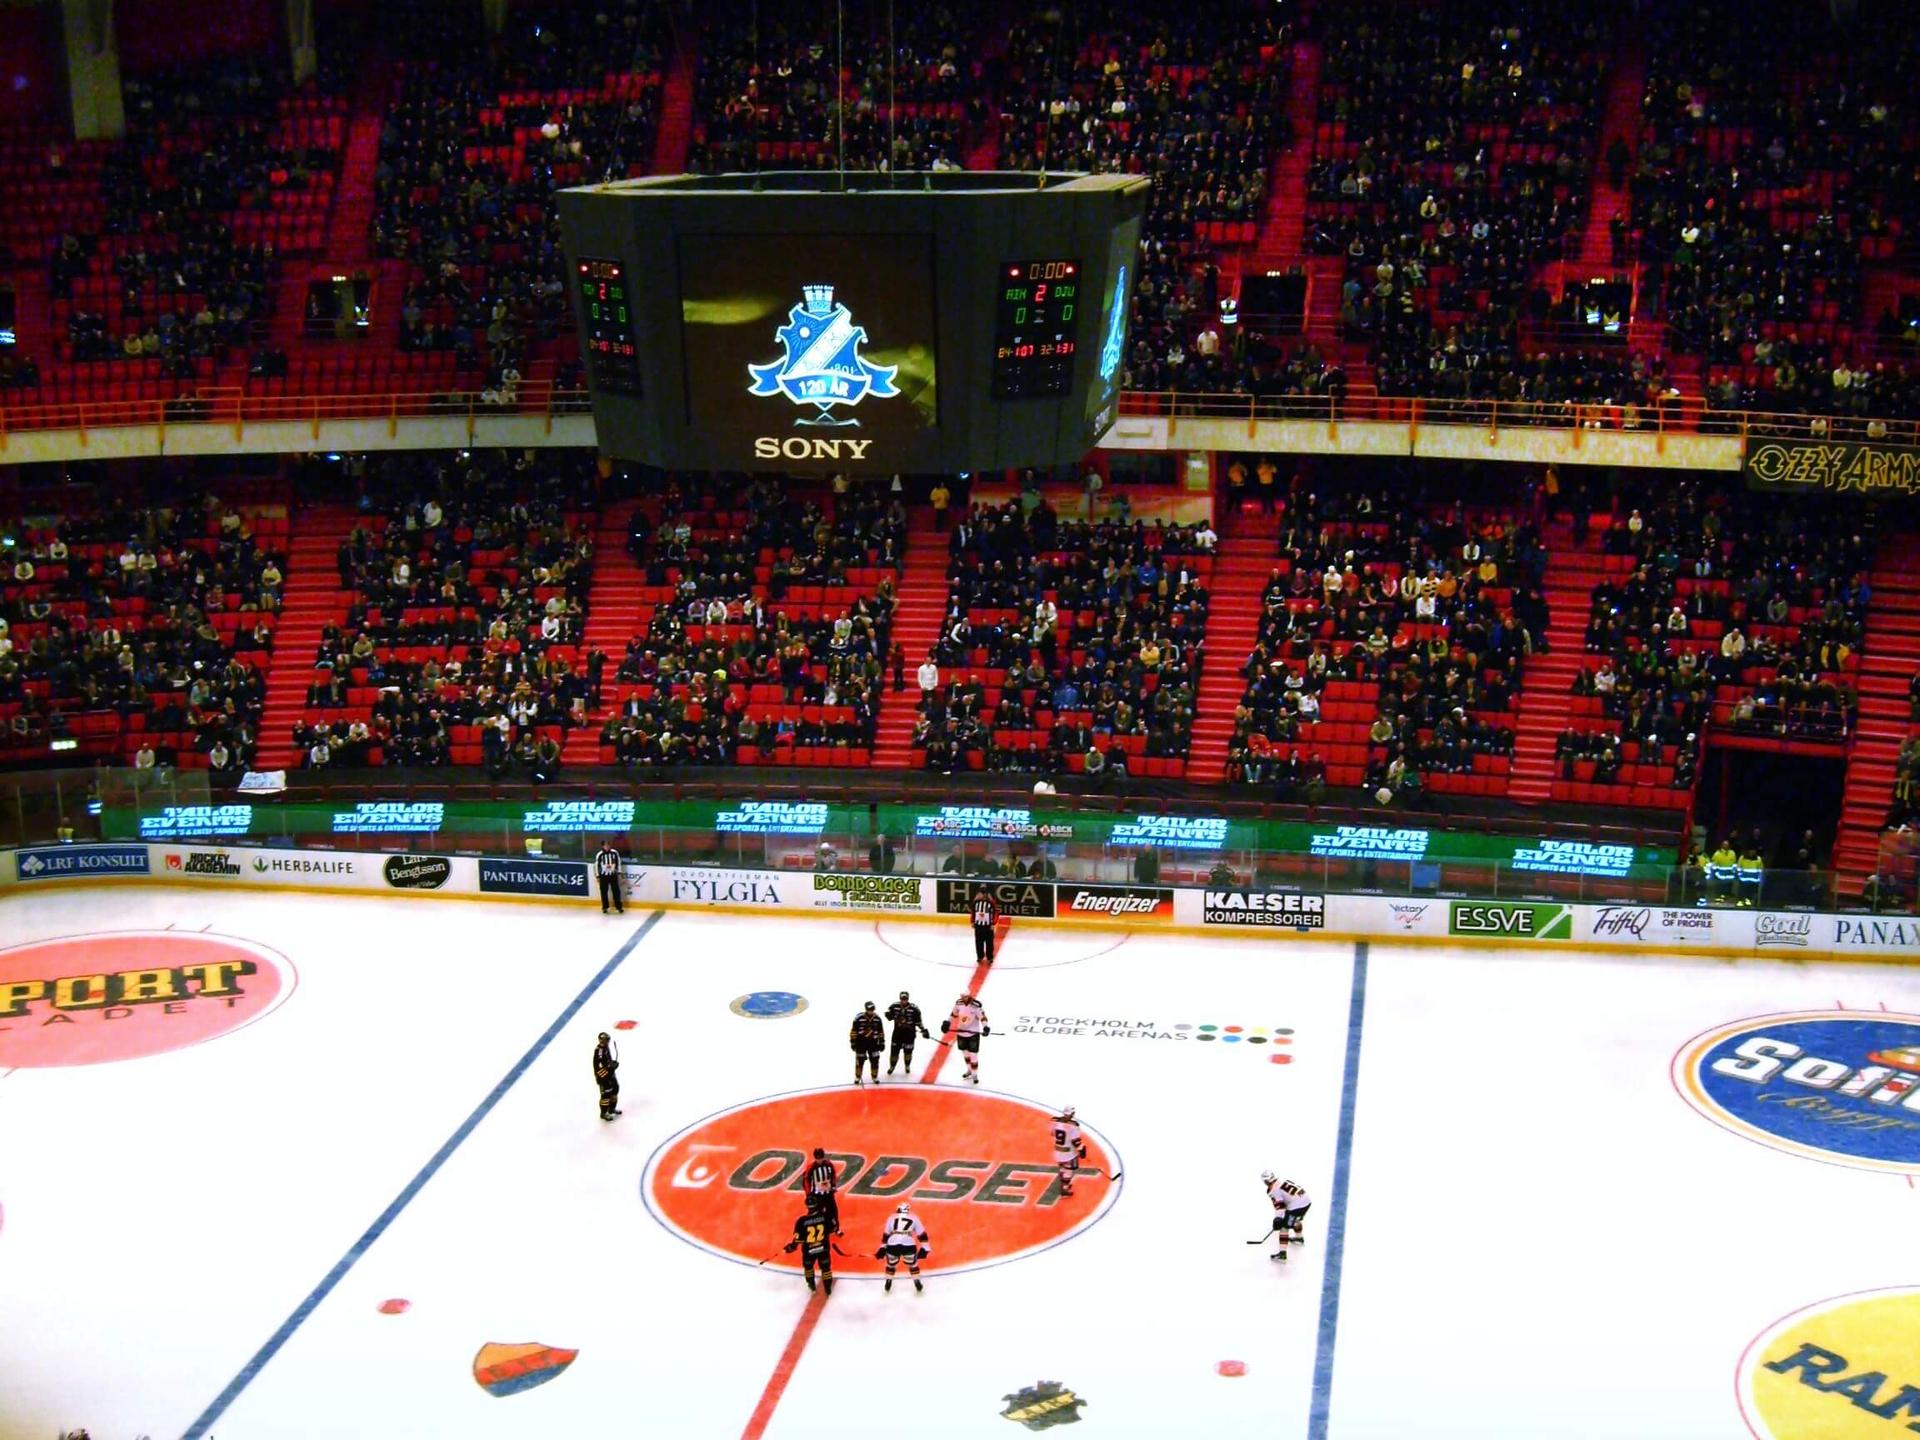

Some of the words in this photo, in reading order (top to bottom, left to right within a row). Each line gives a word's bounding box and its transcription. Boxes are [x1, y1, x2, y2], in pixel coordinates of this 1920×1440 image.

[1029, 262, 1066, 280] 0:00
[1035, 284, 1047, 302] 2
[1055, 286, 1075, 298] DJU
[1015, 307, 1026, 324] 0
[1062, 304, 1073, 321] 0
[799, 379, 825, 396] 120
[755, 437, 872, 459] SONY
[1749, 444, 1846, 487] OZZY
[357, 803, 444, 813] TAILOR
[547, 802, 635, 812] TAILOR
[740, 802, 828, 814] TAILOR
[941, 806, 1030, 820] TAILOR
[141, 816, 252, 828] EVENTS
[333, 813, 444, 824] EVENTS
[523, 812, 635, 822] EVENTS
[716, 812, 828, 824] EVENTS
[1137, 816, 1228, 830] TAILOR
[1112, 825, 1227, 840] EVENTS
[1337, 826, 1429, 841] TAILOR
[1311, 835, 1428, 851] EVENTS
[1540, 841, 1634, 857] TAILOR
[189, 852, 230, 864] HOCKEY
[1328, 849, 1356, 857] SPORTS
[1512, 849, 1633, 868] EVENTS
[46, 857, 75, 870] LRF
[79, 855, 146, 868] KONSULT
[184, 861, 240, 875] AKADEMIN
[272, 859, 354, 874] HERBALIFE
[1530, 863, 1559, 871] SPORTS
[390, 863, 446, 880] Bengtsson
[483, 870, 585, 886] PANTBANKEN.SE
[673, 879, 781, 903] FYLGIA
[814, 875, 921, 893] BORRBOLAGET
[949, 882, 1040, 904] HGA
[949, 902, 1040, 915] MASINET
[1071, 891, 1160, 916] Energizer
[1205, 892, 1323, 913] KAESER
[1205, 911, 1322, 926] KOMPRESSORER
[1455, 907, 1533, 932] ESSVE
[1662, 911, 1678, 919] THE
[1681, 911, 1712, 920] POWER
[1662, 919, 1675, 927] OF
[1677, 920, 1713, 928] PROFILE
[1756, 913, 1810, 935] Goal
[1018, 1015, 1155, 1029] STOCKHOLM
[1013, 1025, 1086, 1036] GLOBE
[1094, 1029, 1188, 1041] ARENAS
[1054, 1129, 1066, 1145] 9
[726, 1148, 1101, 1208] ODDSET
[893, 1217, 913, 1231] 17
[806, 1223, 825, 1243] 22
